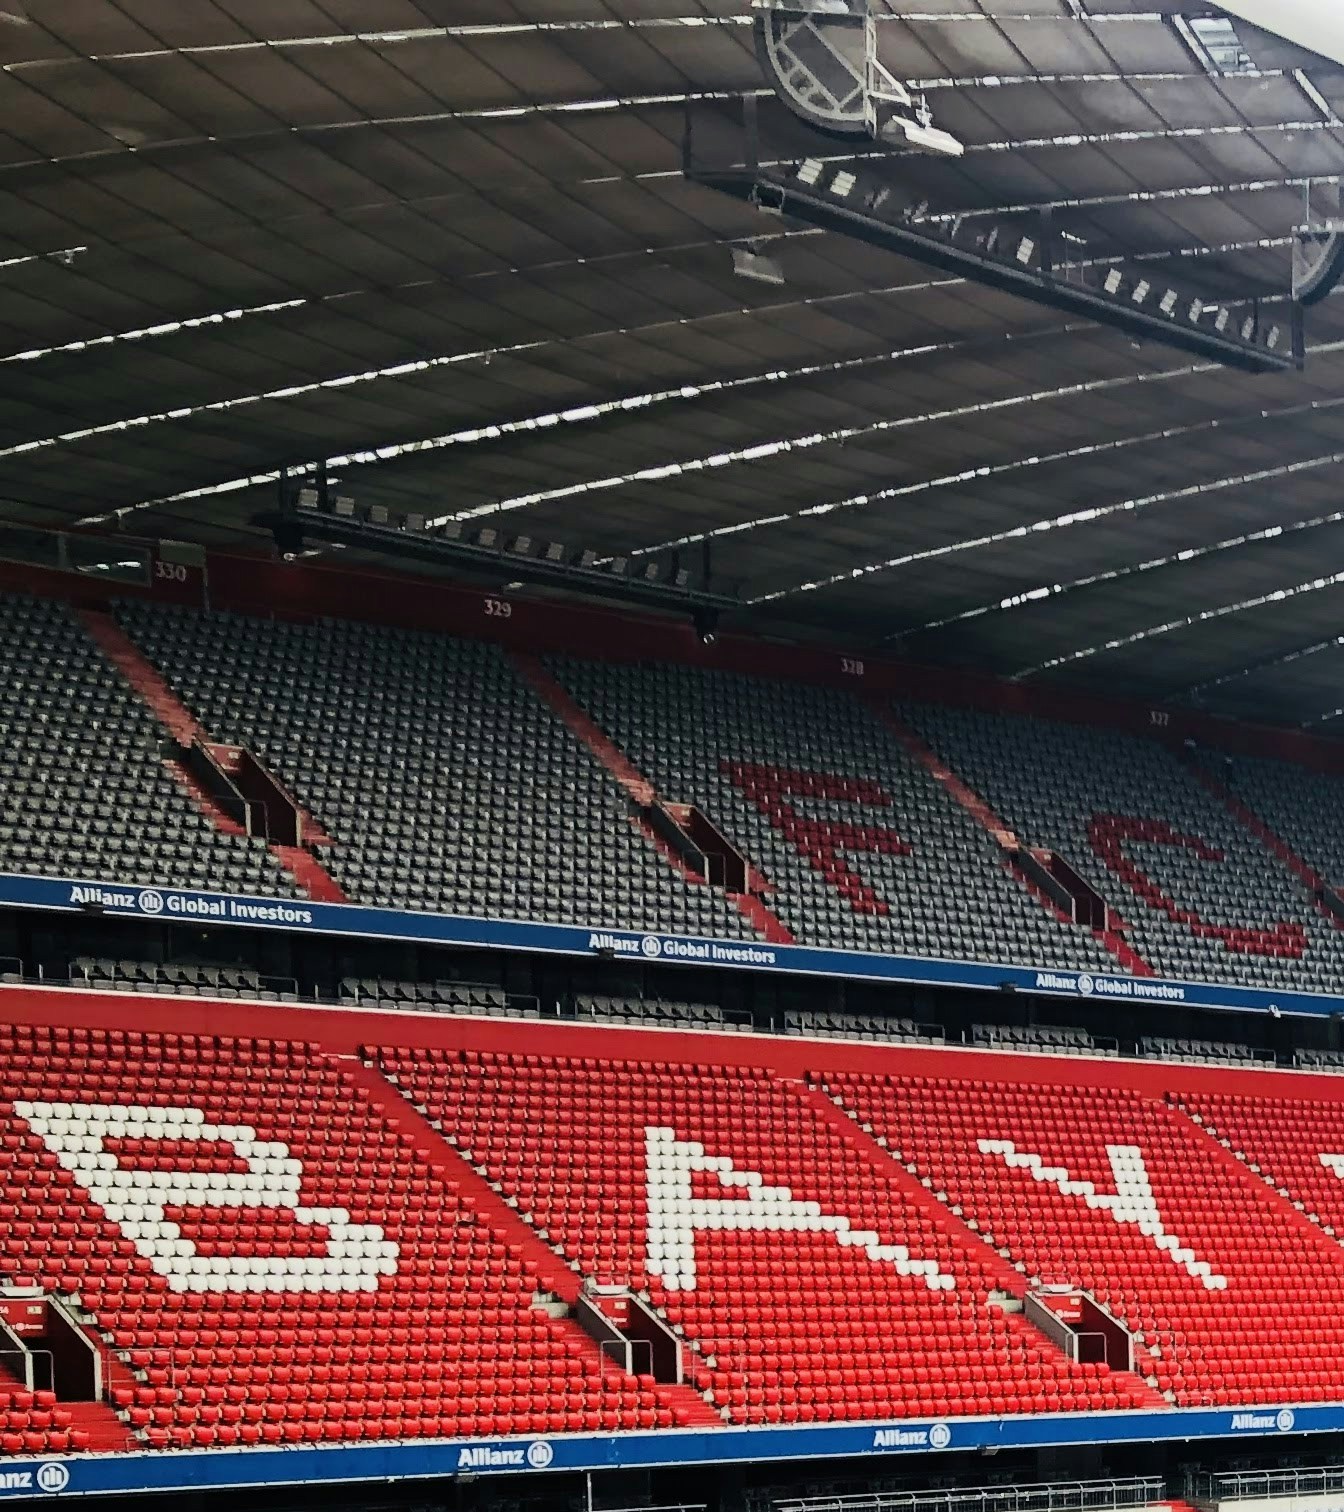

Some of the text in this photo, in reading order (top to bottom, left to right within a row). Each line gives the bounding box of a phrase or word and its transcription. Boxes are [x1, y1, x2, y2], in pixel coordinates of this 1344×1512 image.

[155, 561, 187, 582] 330
[483, 599, 512, 618] 329
[70, 885, 312, 924] Allianz Global Investors
[589, 933, 776, 963] Allianz Global Investors
[1036, 973, 1185, 999] Allianz Global Investors
[1231, 1413, 1276, 1430] Allianz
[873, 1429, 928, 1447] Allianz
[457, 1448, 525, 1467] Allianz
